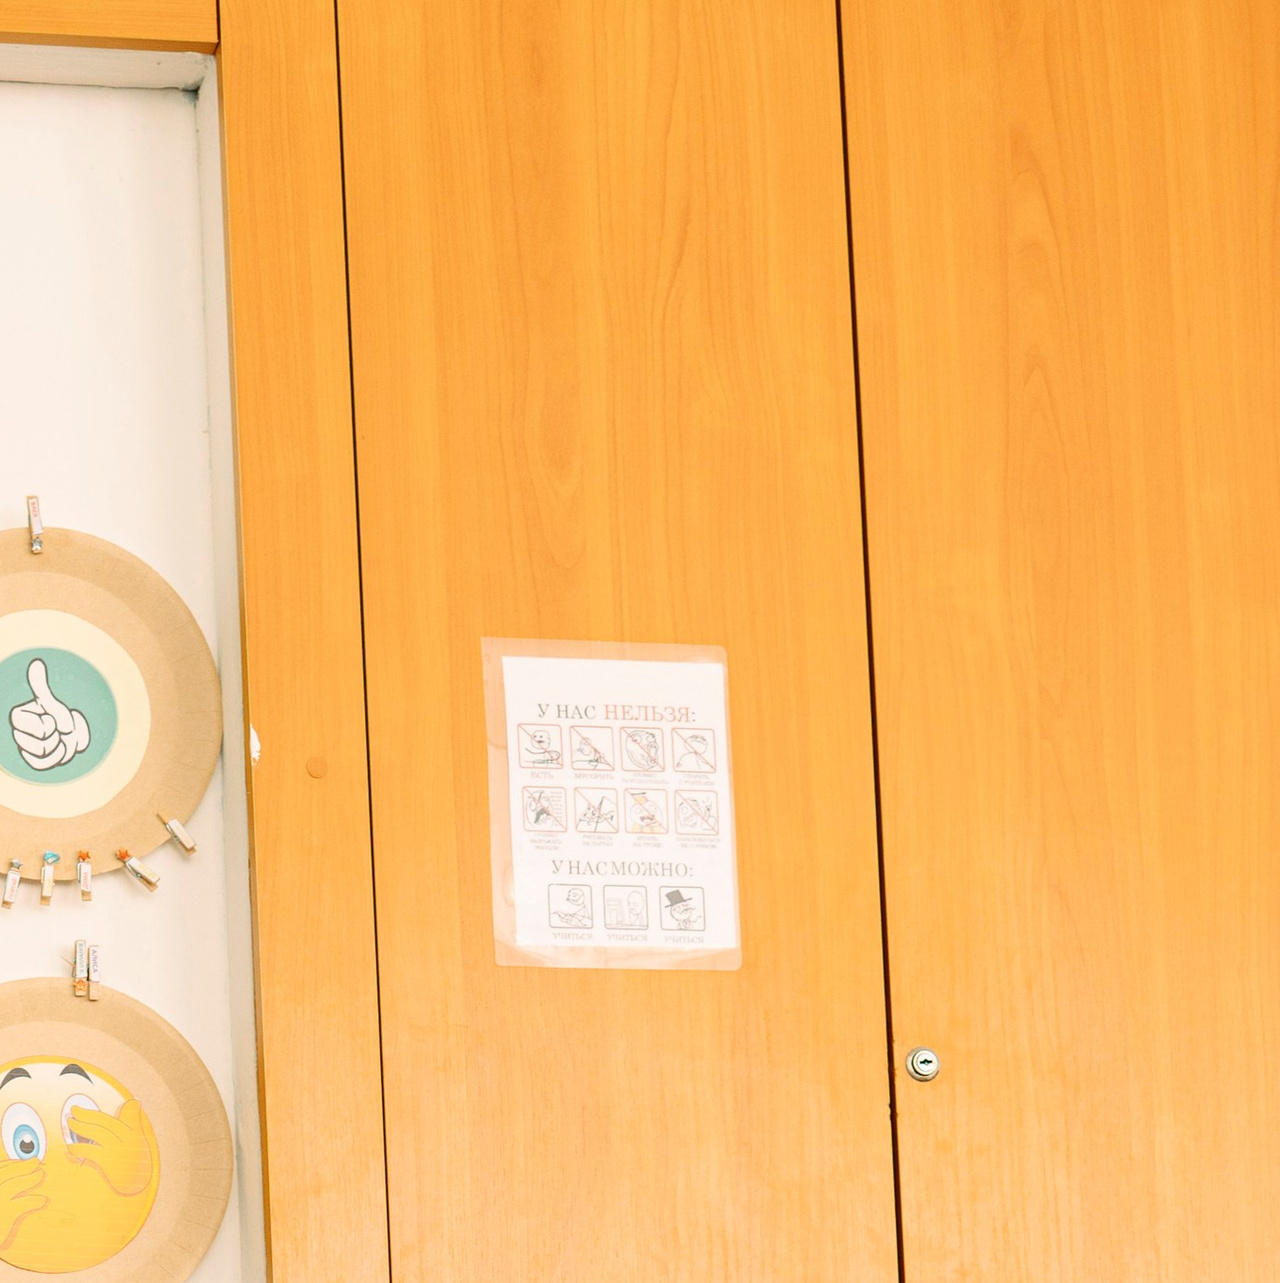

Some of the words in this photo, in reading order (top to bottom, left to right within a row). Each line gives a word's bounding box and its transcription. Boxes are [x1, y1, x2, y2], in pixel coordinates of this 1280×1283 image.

[537, 704, 550, 719] У
[556, 704, 596, 719] НАС
[604, 705, 696, 723] НЕЛЬЗЯ:
[552, 860, 563, 875] У
[568, 860, 608, 876] НАС
[611, 861, 694, 877] МОЖНО:
[552, 932, 593, 940] УЧИТЬСЯ
[607, 933, 648, 942] УЧИТЬСЯ
[664, 935, 704, 944] УЧИТЬСЯ
